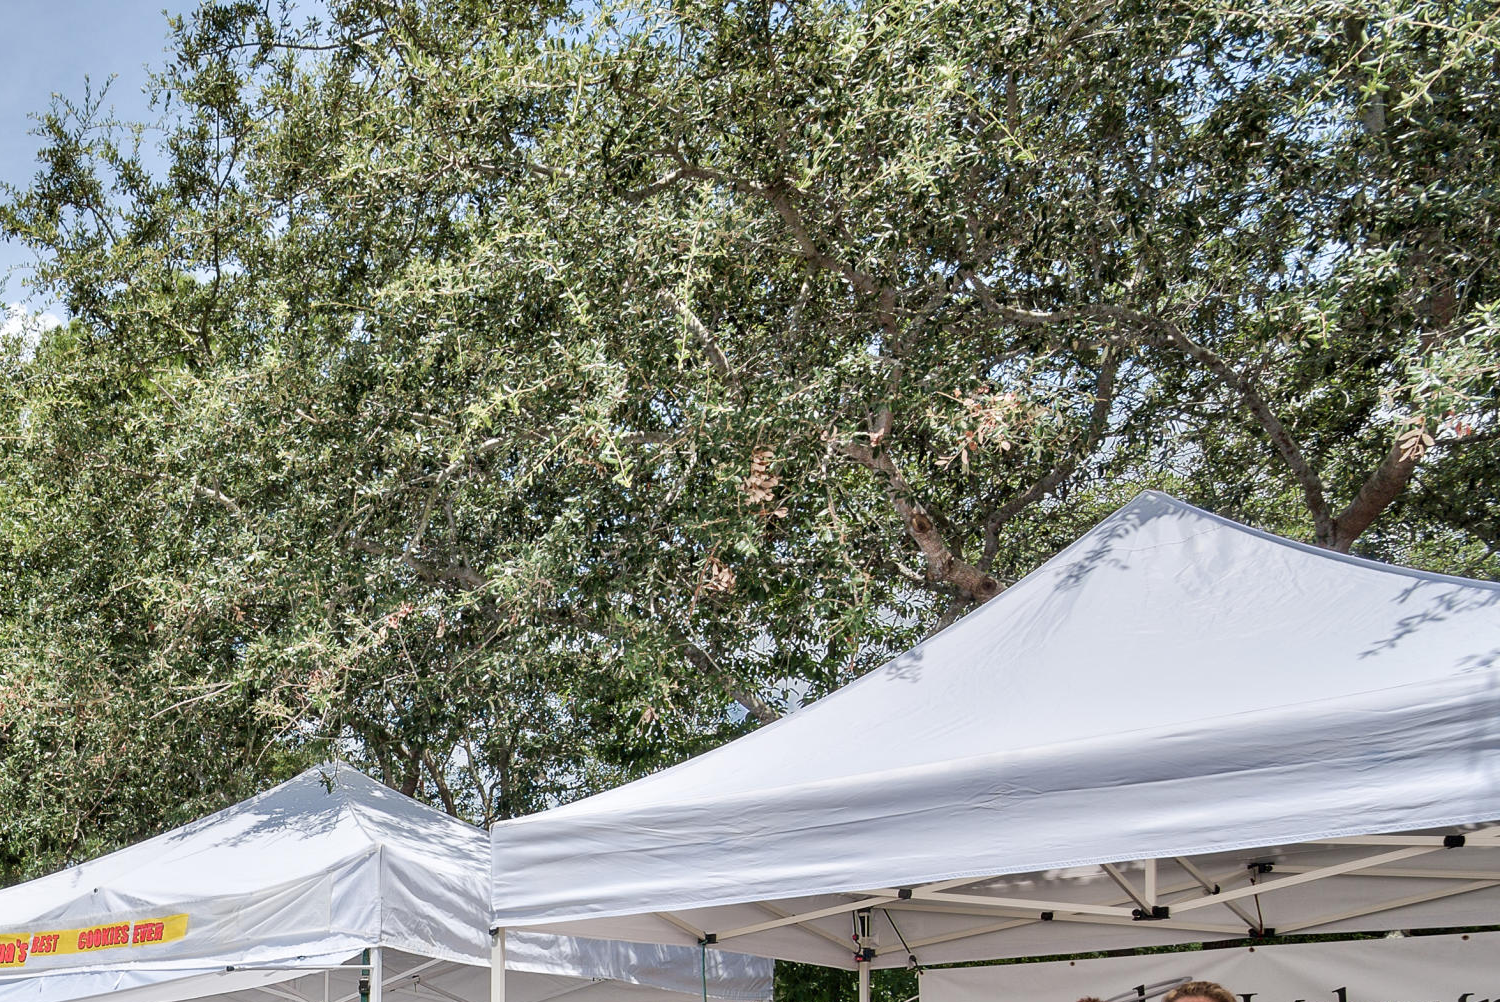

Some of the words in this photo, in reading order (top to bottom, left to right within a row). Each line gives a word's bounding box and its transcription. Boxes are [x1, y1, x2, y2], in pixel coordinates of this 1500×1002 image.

[30, 934, 60, 954] BEST
[77, 924, 130, 950] COOKIES
[132, 922, 165, 943] EVER
